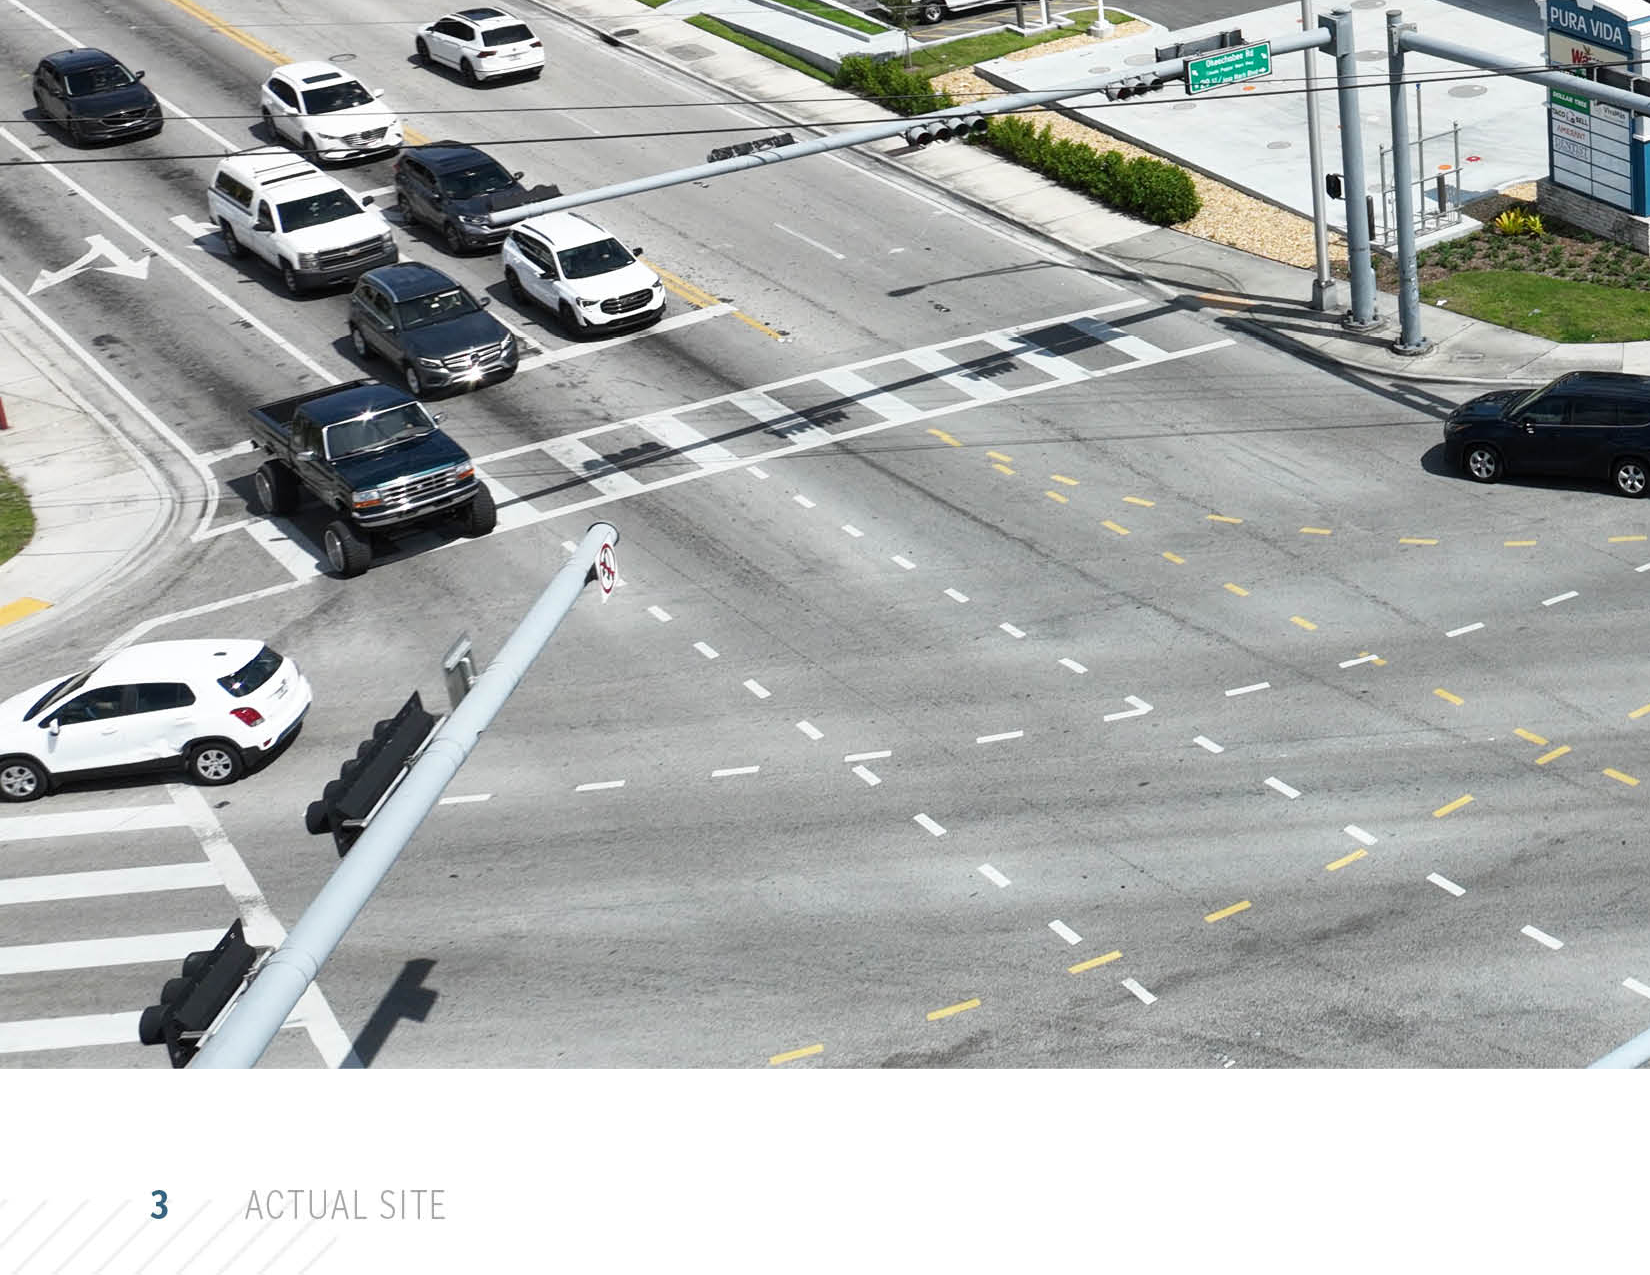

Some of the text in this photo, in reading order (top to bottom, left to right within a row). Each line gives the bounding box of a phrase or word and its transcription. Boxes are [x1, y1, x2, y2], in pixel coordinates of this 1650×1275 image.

[1550, 6, 1624, 46] PURA VIDA
[1552, 91, 1573, 103] DOLLAR
[1575, 116, 1588, 127] BELL
